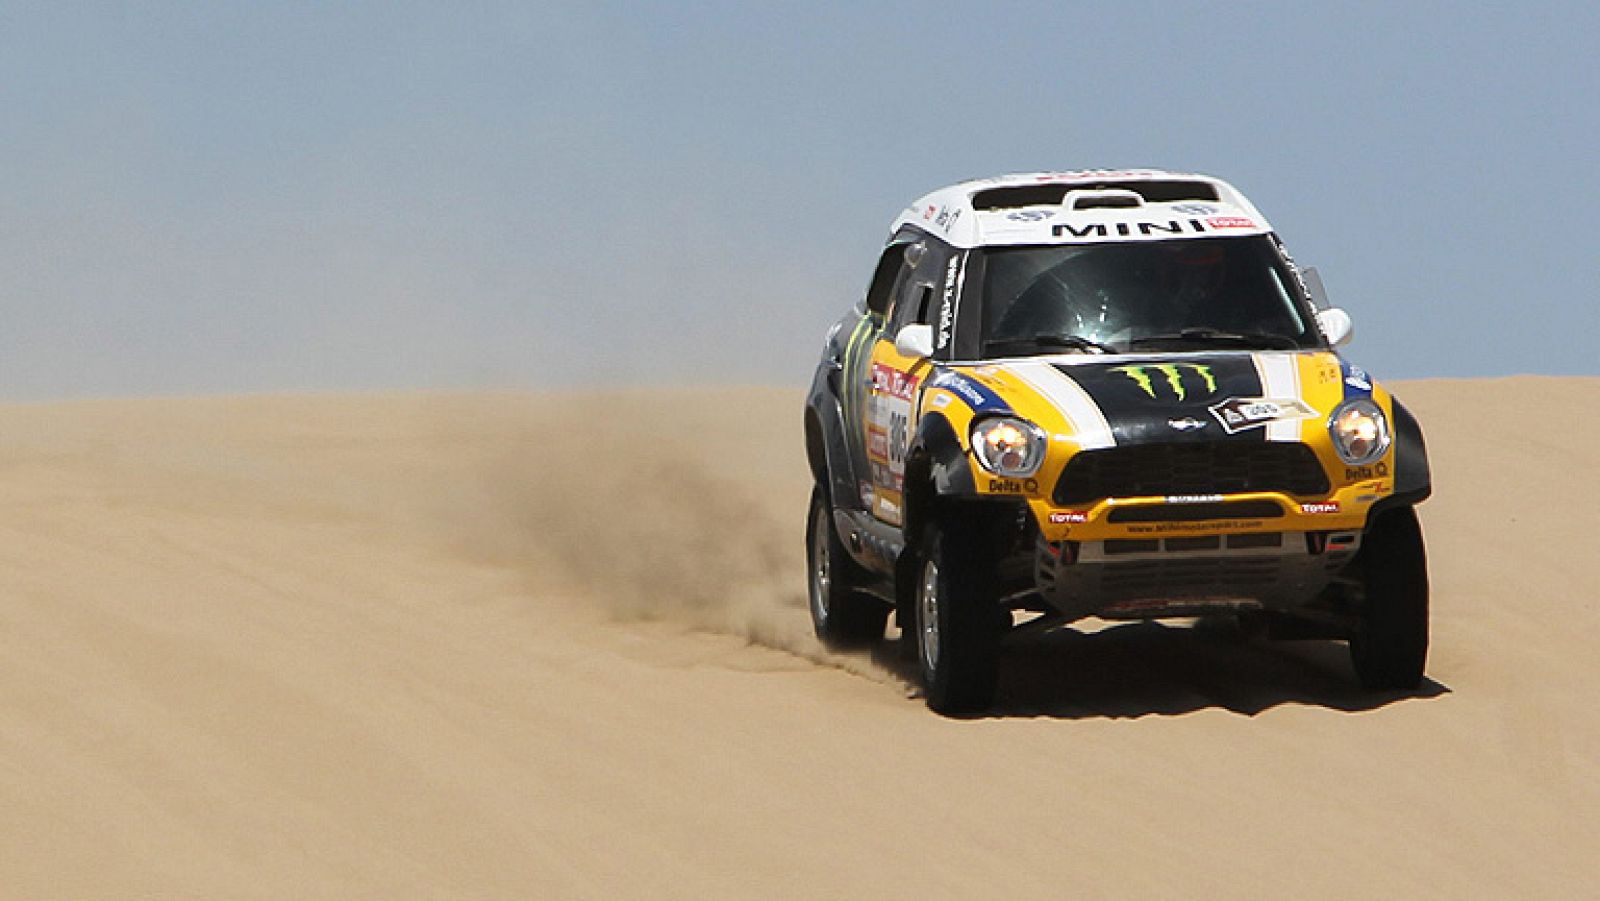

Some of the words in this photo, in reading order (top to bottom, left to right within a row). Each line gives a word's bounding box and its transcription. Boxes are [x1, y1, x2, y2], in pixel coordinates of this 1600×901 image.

[1052, 219, 1206, 237] MINI
[1345, 467, 1372, 480] Delta
[989, 478, 1021, 493] Delta
[1302, 503, 1339, 513] TOTAL
[1049, 513, 1087, 523] TOTAL
